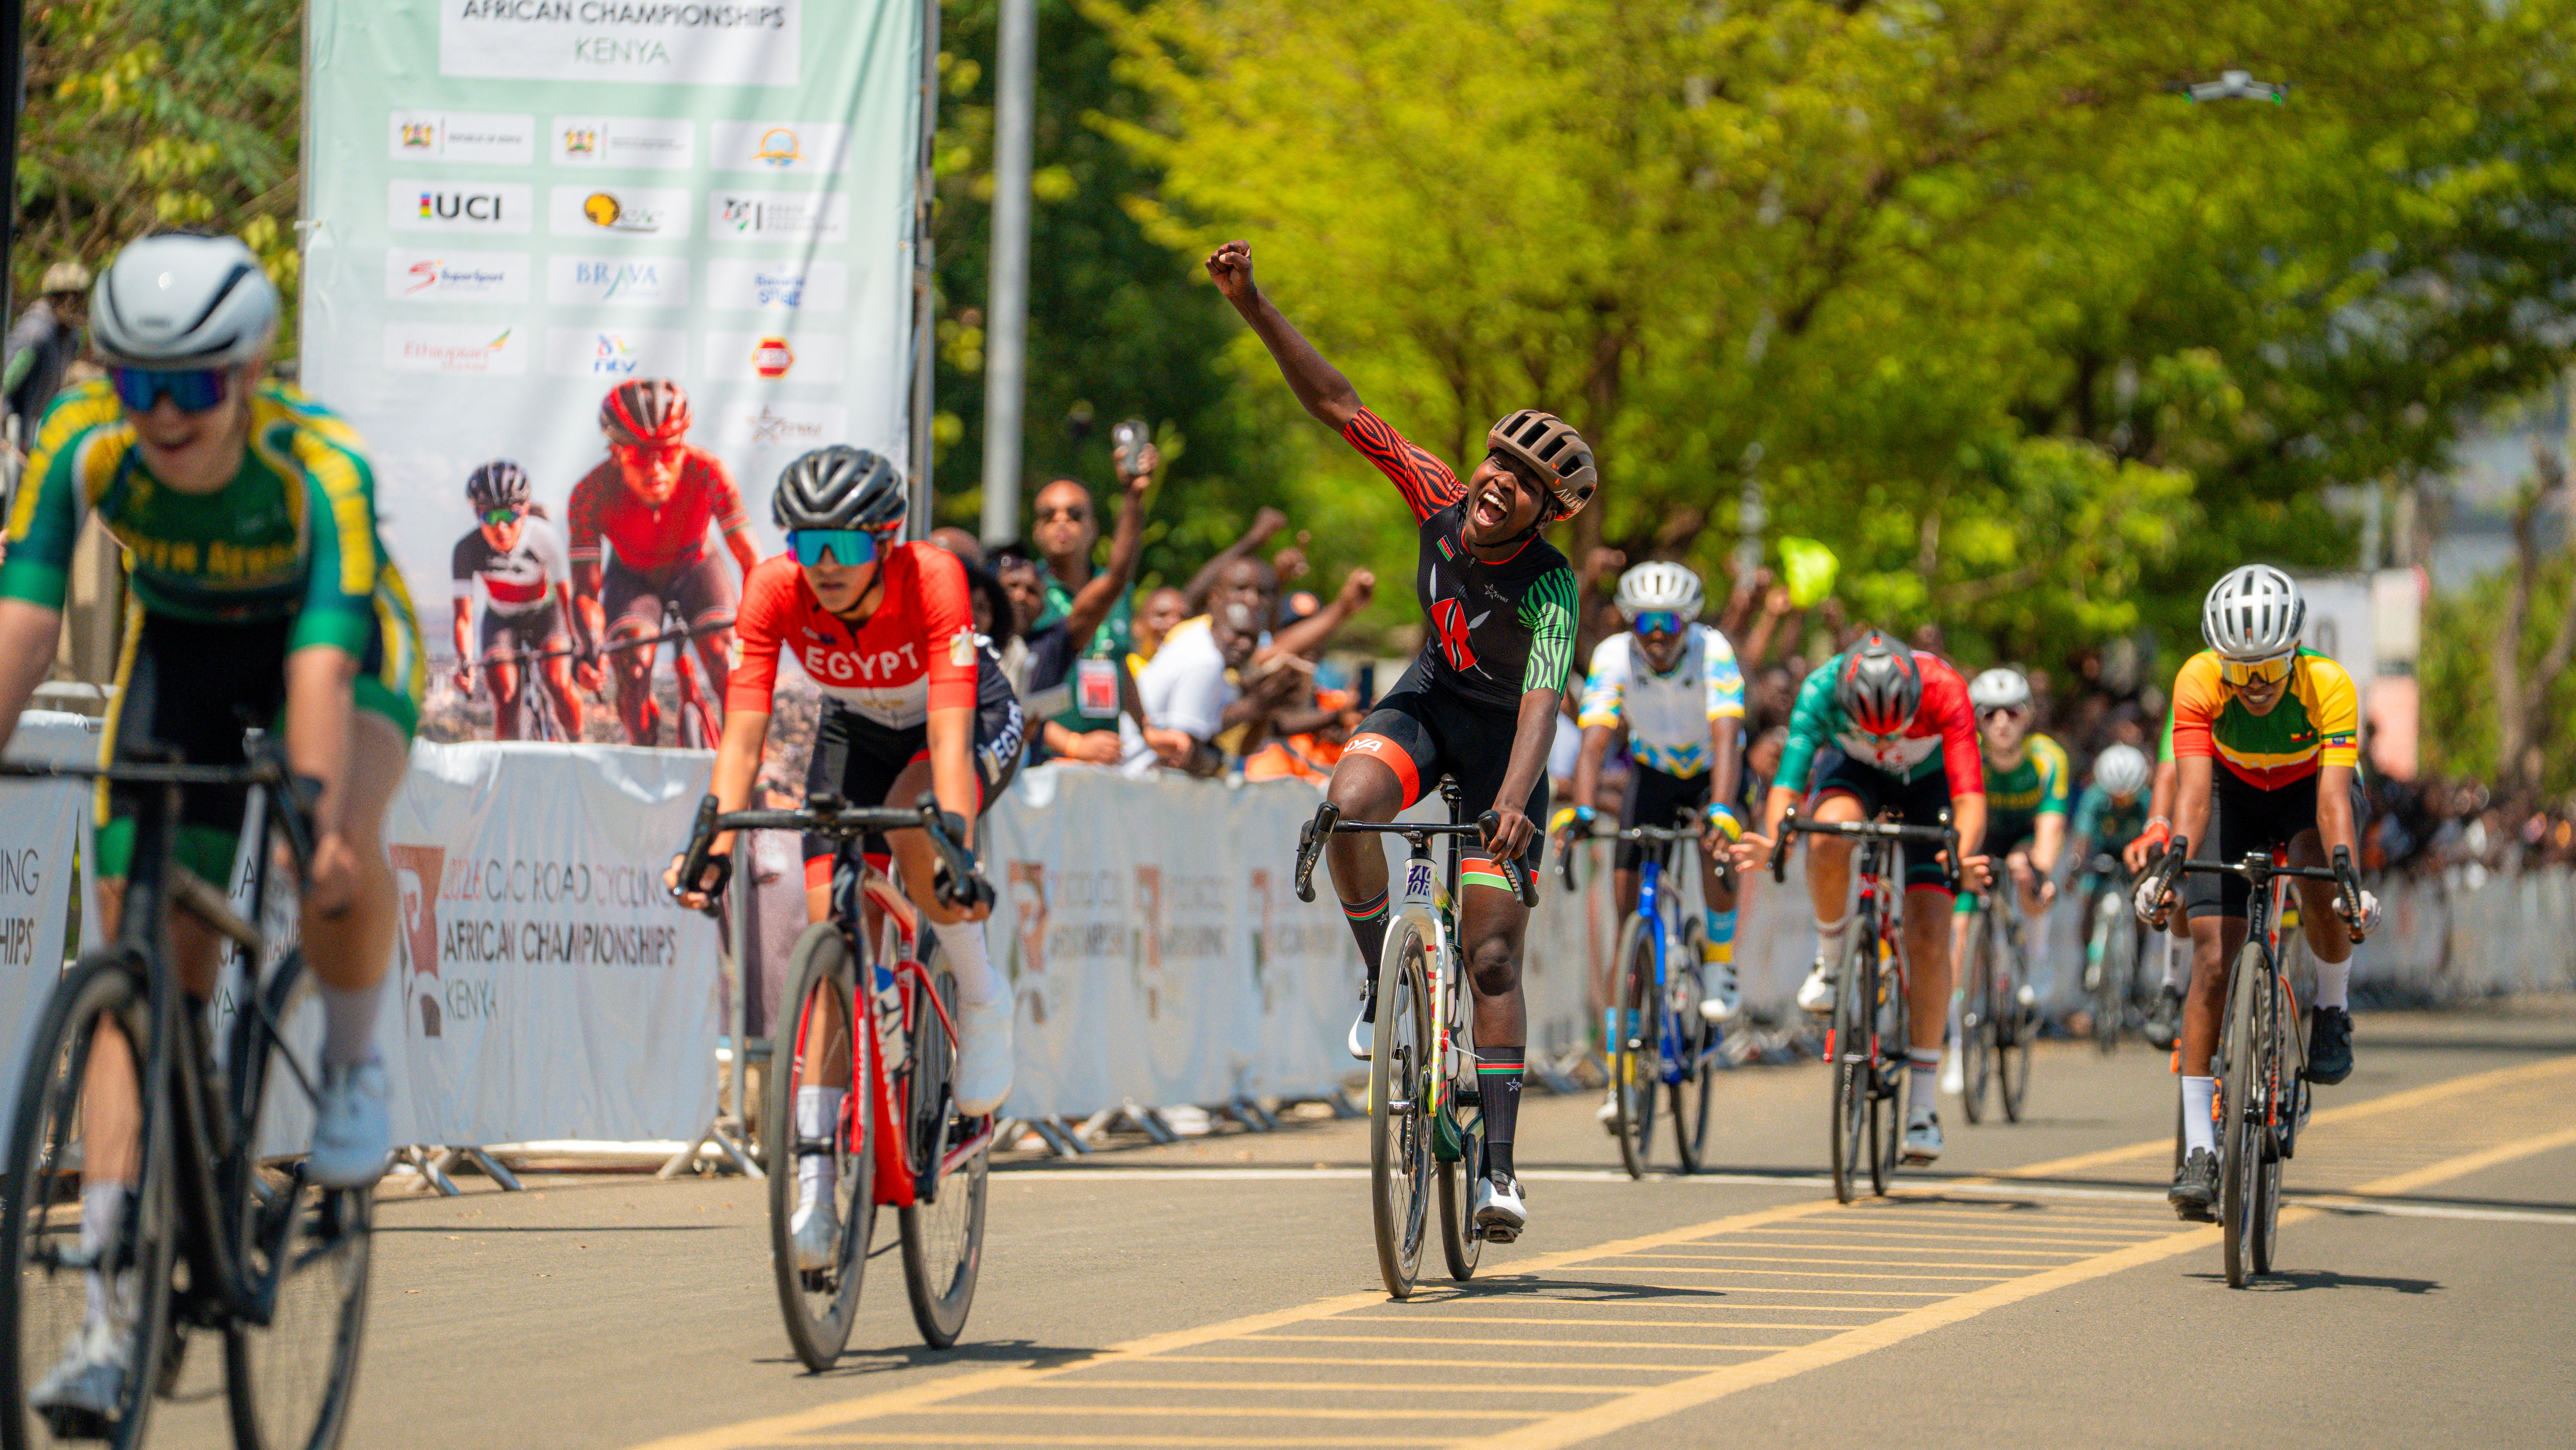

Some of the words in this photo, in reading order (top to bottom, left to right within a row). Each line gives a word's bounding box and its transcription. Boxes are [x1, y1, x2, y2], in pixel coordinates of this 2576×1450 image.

[462, 0, 572, 22] AFRICAN
[580, 3, 785, 29] CHAMPIONSHIPS
[575, 37, 670, 64] KENYA
[436, 193, 501, 221] UCI
[576, 261, 658, 295] BRAVA
[805, 642, 919, 681] EGYPT
[534, 860, 591, 905] ROAD
[443, 918, 515, 963] AFRICAN
[522, 920, 677, 968] CHAMPIONSHIPS
[444, 978, 498, 1019] KENYA
